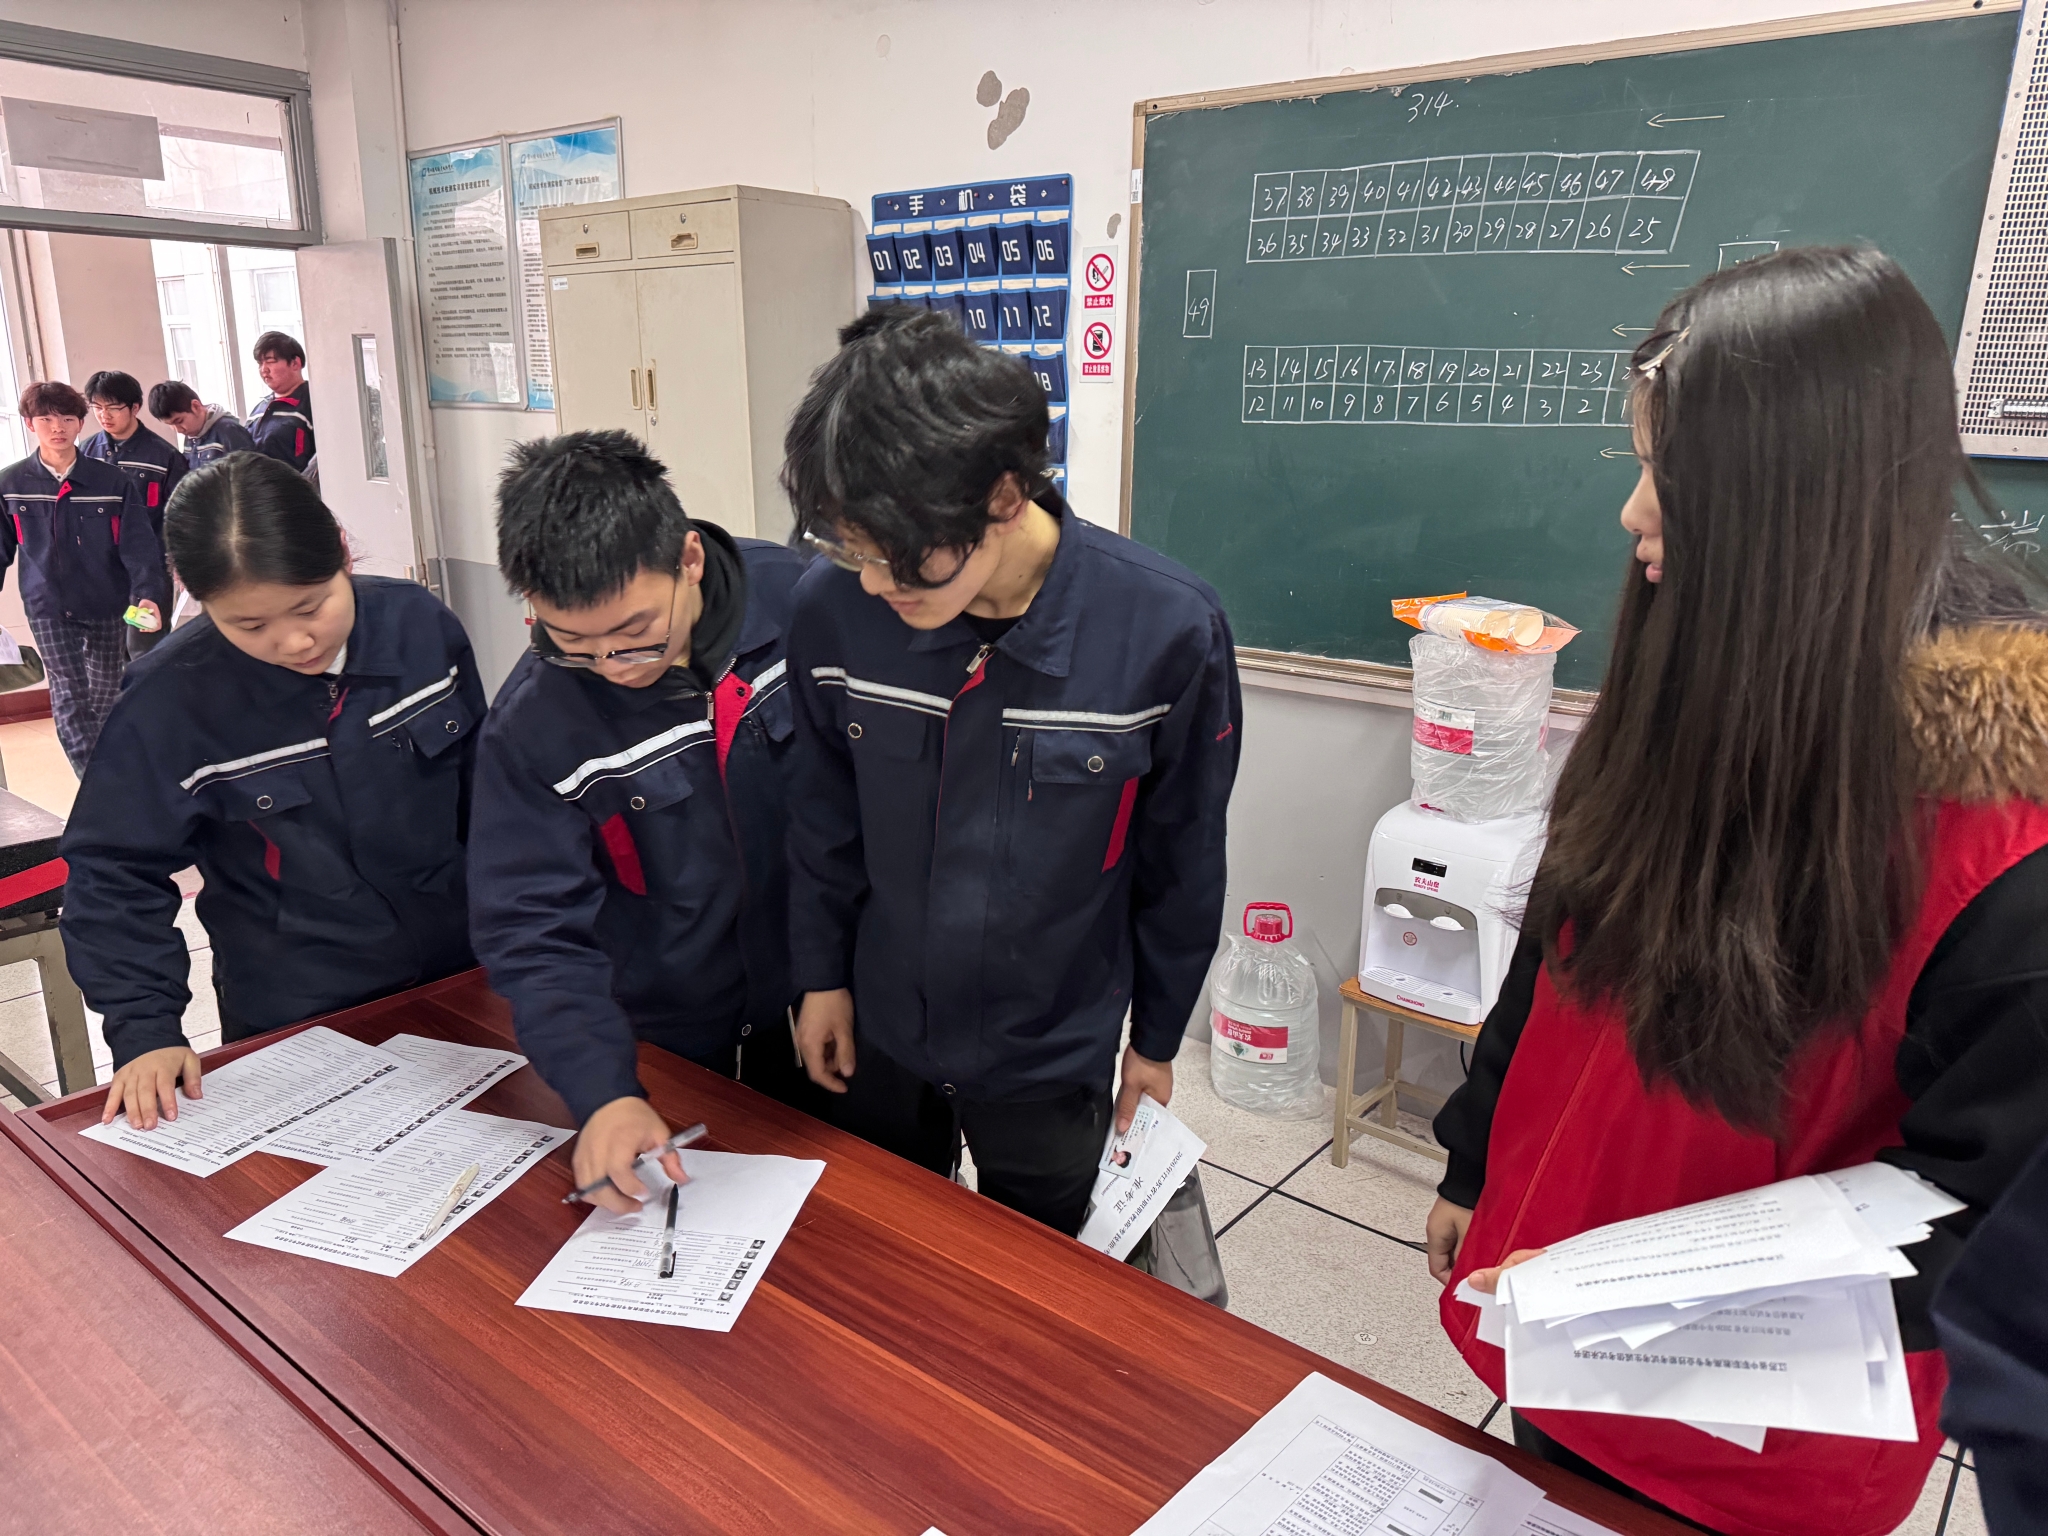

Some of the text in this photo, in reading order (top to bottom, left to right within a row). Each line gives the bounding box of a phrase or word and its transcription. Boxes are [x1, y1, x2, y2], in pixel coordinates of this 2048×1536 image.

[908, 183, 1027, 216] 手机袋
[1263, 168, 1676, 213] 37 38 39 40 41 42 43 44 45 46 47 48
[1257, 214, 1662, 256] 36 35 34 33 32 31 30 29 28 27 26 25
[873, 239, 1055, 271] 01 02 03 04 05 06
[1086, 296, 1112, 307] 禁止烟火
[1188, 294, 1212, 328] 49
[968, 305, 1053, 330] 10 11 12
[1034, 371, 1052, 392] 18
[1248, 358, 1267, 379] 13
[1280, 357, 1301, 382] 14
[1314, 357, 1334, 380] 15
[1340, 356, 1362, 378] 16
[1374, 360, 1396, 383] 17
[1407, 361, 1429, 379] 18
[1438, 362, 1458, 382] 19
[1468, 363, 1490, 377] 20
[1502, 364, 1522, 380] 21
[1541, 362, 1566, 378] 22
[1581, 361, 1603, 383] 23
[1248, 396, 1266, 414] 12
[1282, 396, 1294, 411] 11
[1310, 397, 1324, 411] 10
[1344, 393, 1356, 417] 9
[1373, 394, 1384, 414] 8
[1407, 396, 1419, 414] 7
[1435, 392, 1449, 412] 6
[1471, 394, 1482, 412] 5
[1501, 394, 1514, 415] 4
[1539, 399, 1552, 418] 3
[1577, 399, 1593, 414] 2
[1414, 876, 1440, 889] 农夫山泉
[1113, 1176, 1145, 1215] 准考证
